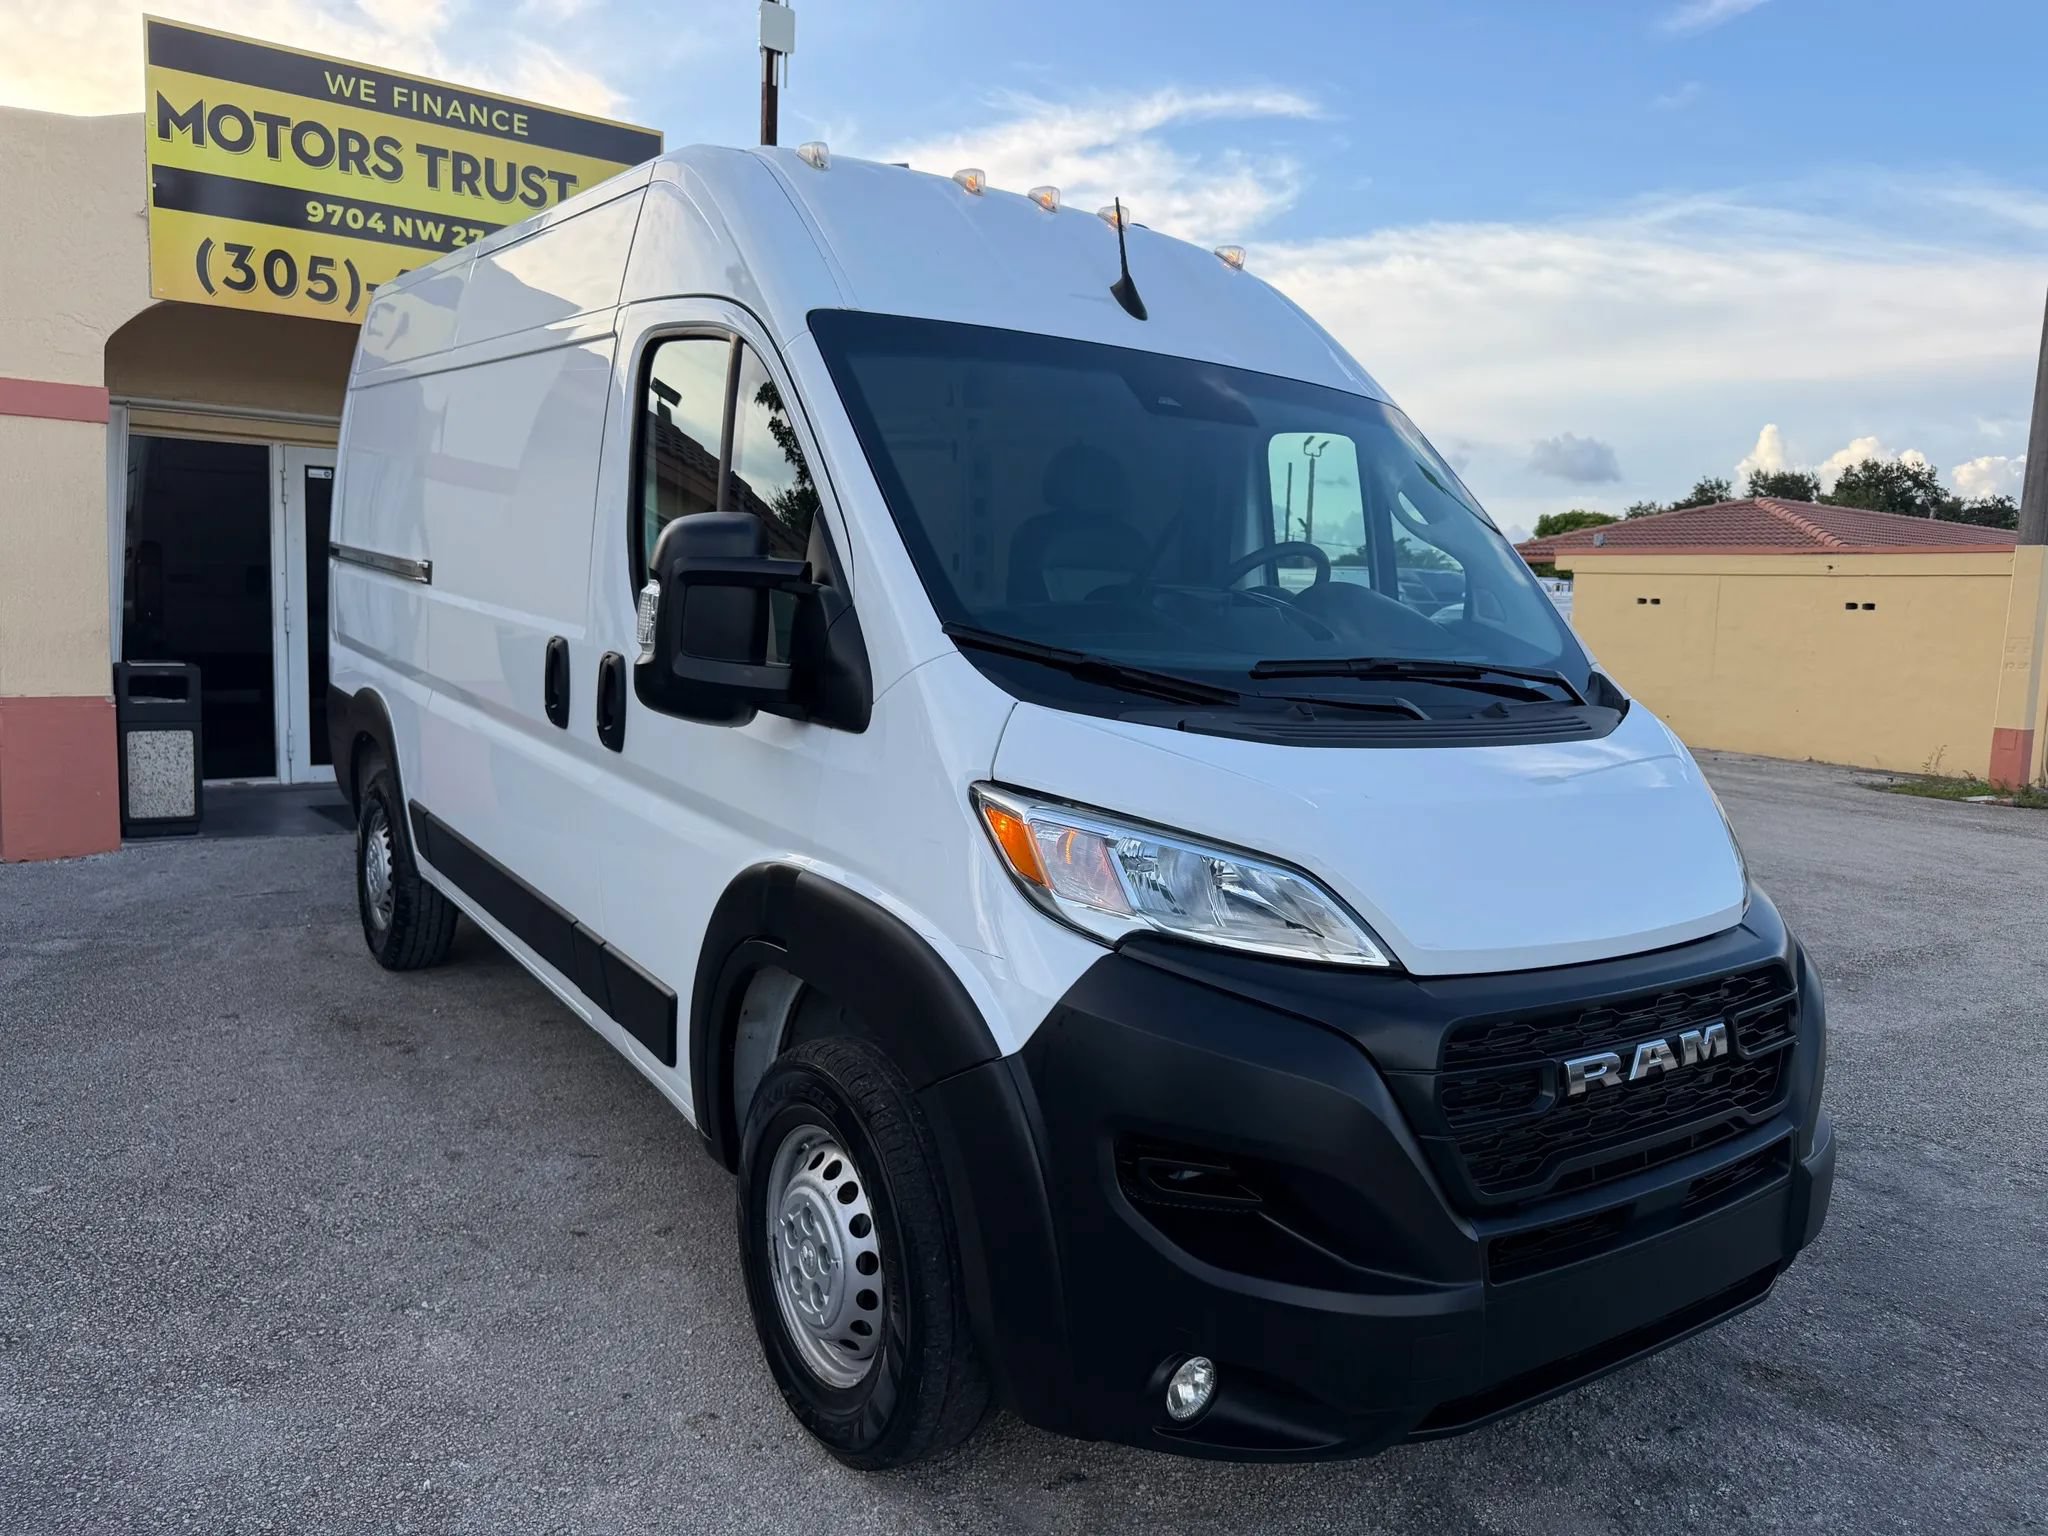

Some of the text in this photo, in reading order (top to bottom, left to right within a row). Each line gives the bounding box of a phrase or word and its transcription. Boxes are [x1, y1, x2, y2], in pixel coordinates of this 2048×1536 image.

[324, 71, 529, 136] WE FINANCE
[156, 90, 578, 207] MOTORS TRUST
[306, 201, 386, 233] 9704
[393, 215, 446, 242] NW
[196, 237, 410, 314] (305)-
[1563, 1022, 1729, 1097] RAM
